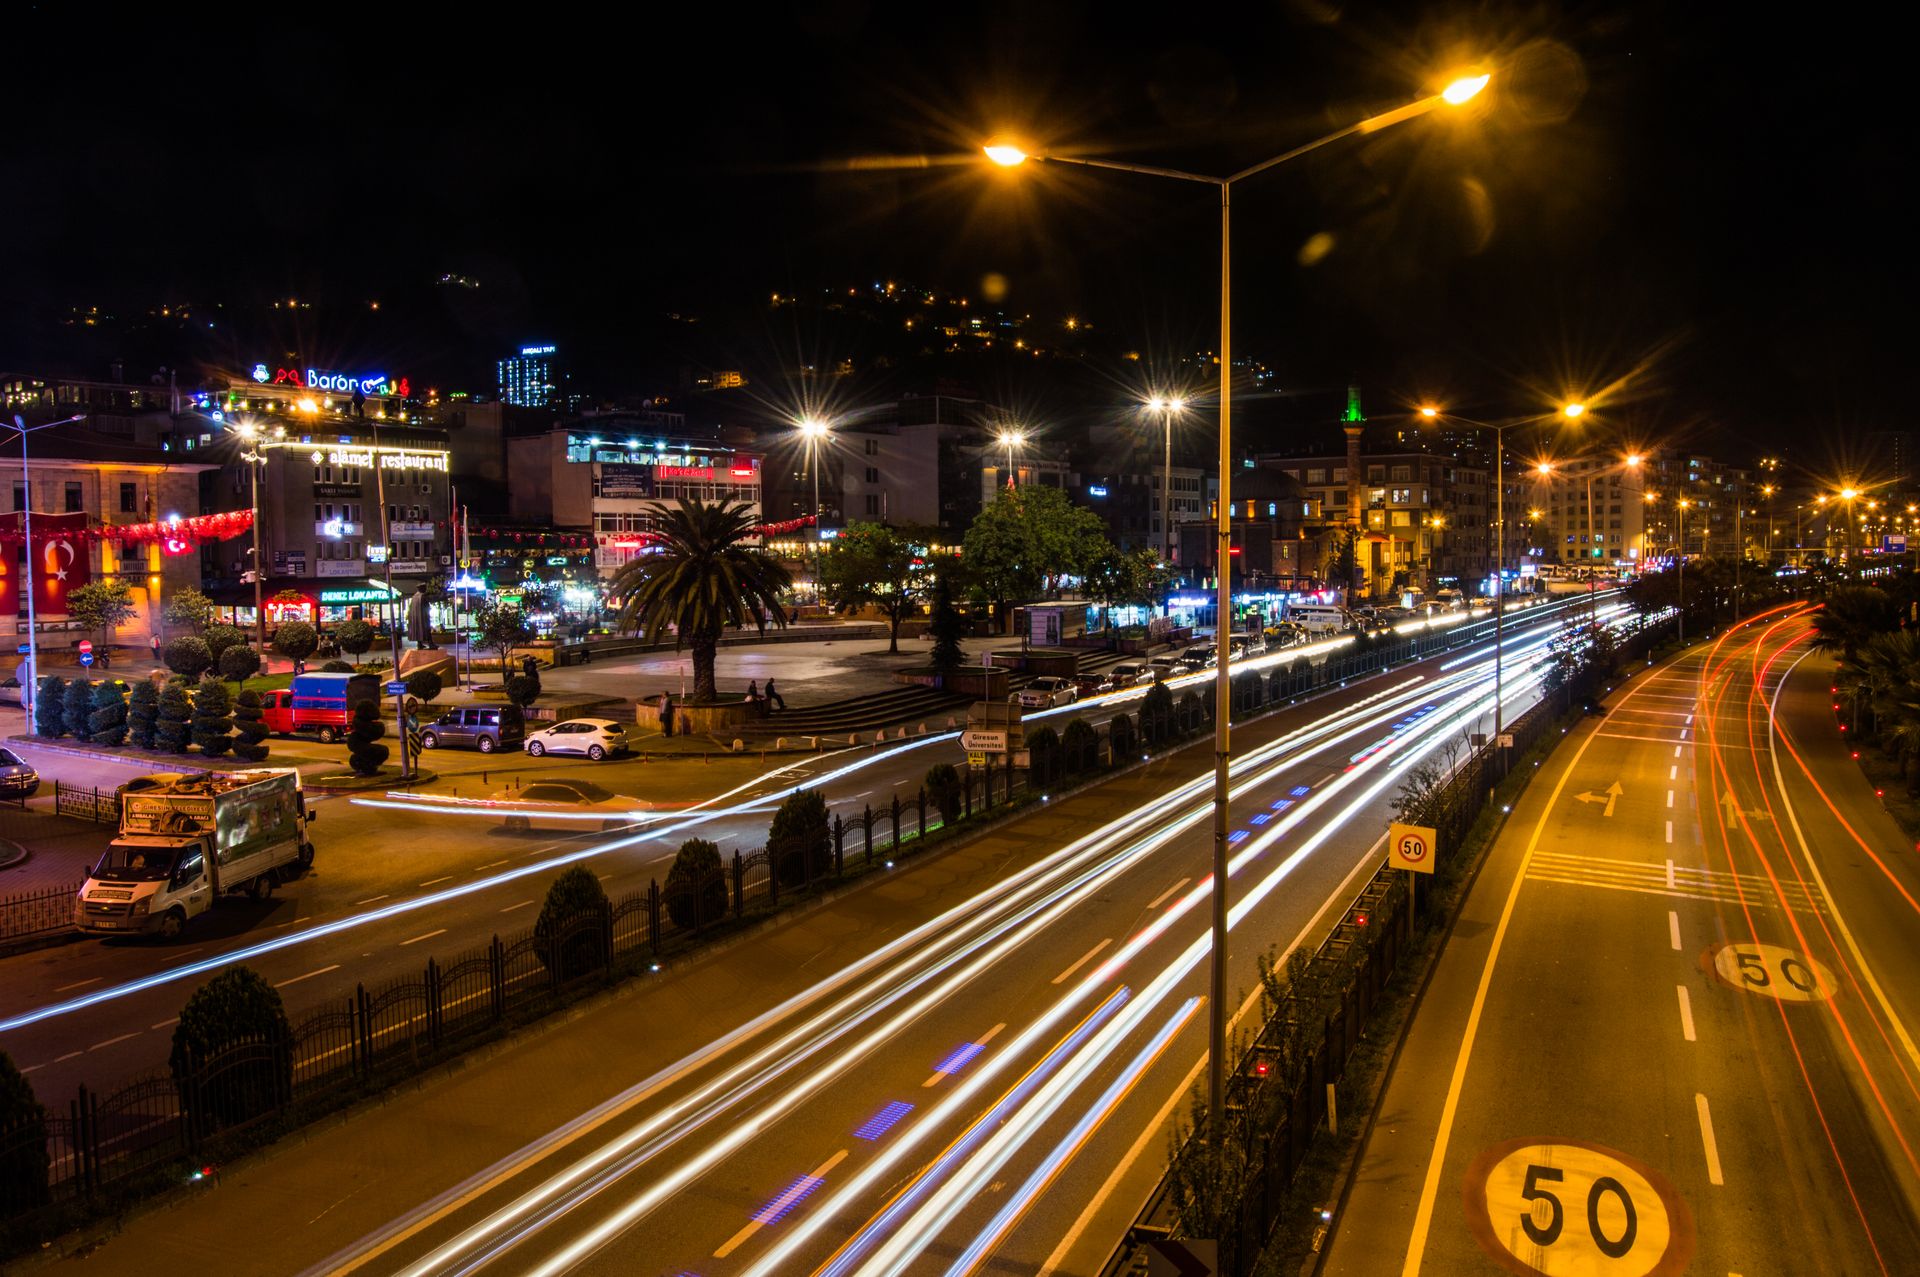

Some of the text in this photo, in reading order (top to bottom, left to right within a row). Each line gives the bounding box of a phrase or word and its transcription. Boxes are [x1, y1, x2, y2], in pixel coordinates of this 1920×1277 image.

[381, 451, 448, 471] restaurant
[1404, 841, 1421, 855] 50
[1737, 953, 1817, 992] 50
[1520, 1164, 1637, 1258] 50
